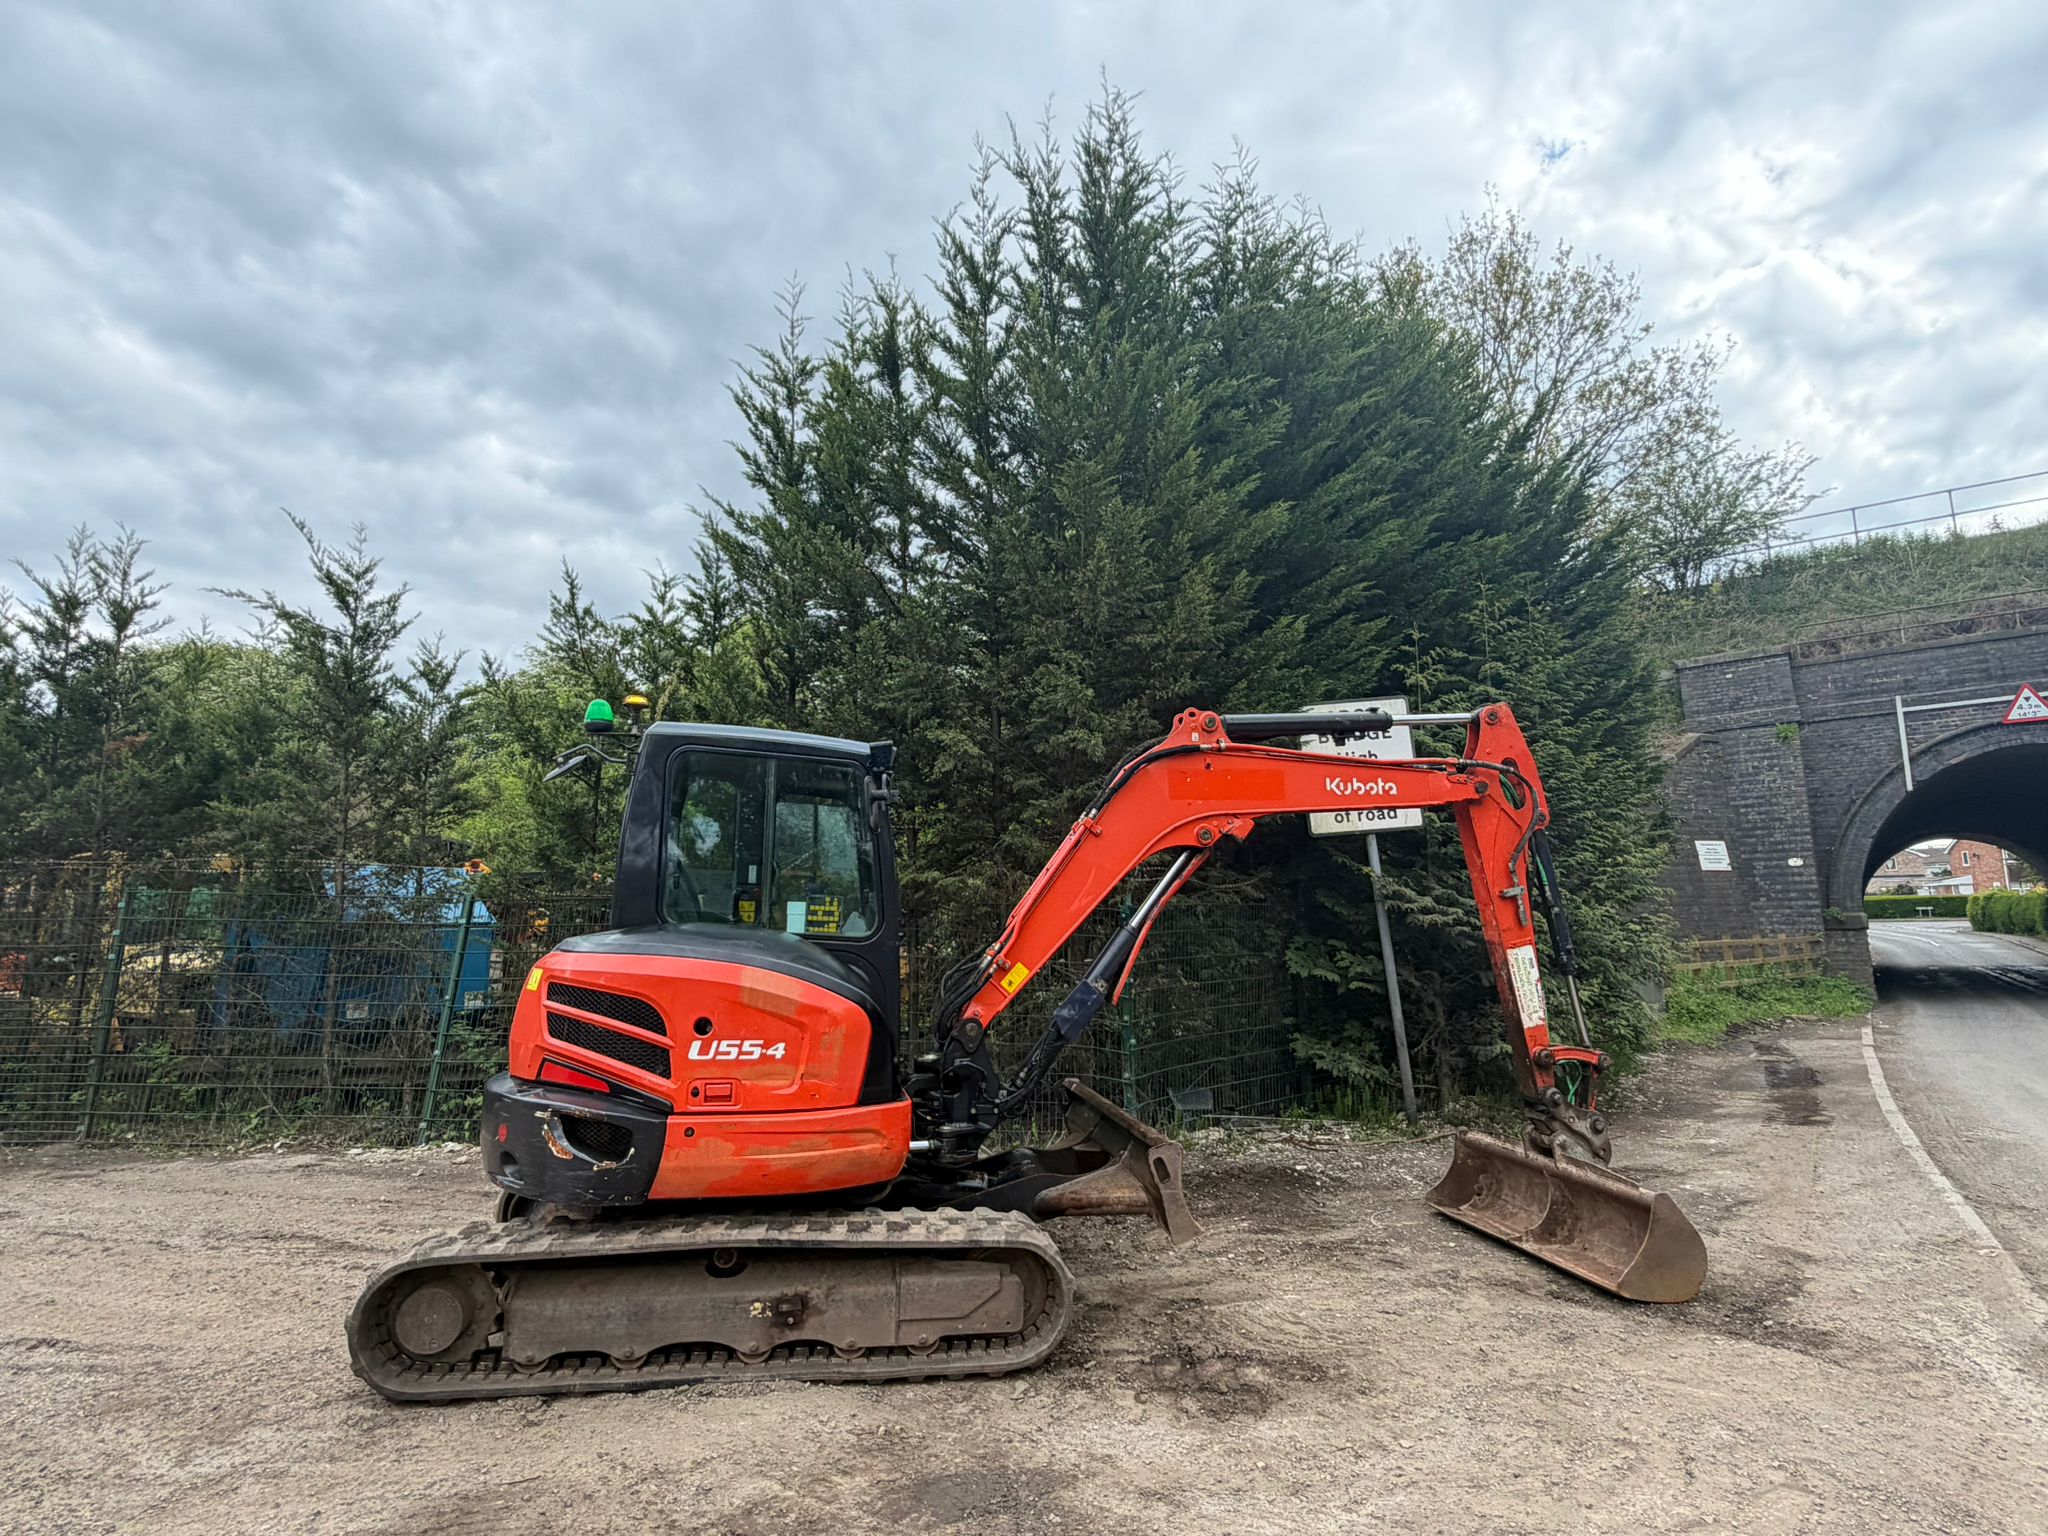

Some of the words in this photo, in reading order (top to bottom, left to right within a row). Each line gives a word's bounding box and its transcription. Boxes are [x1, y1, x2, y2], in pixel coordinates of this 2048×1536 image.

[1325, 777, 1398, 796] Kubota
[1334, 810, 1351, 824] of
[1357, 807, 1398, 822] road
[687, 1039, 786, 1061] U55-4
